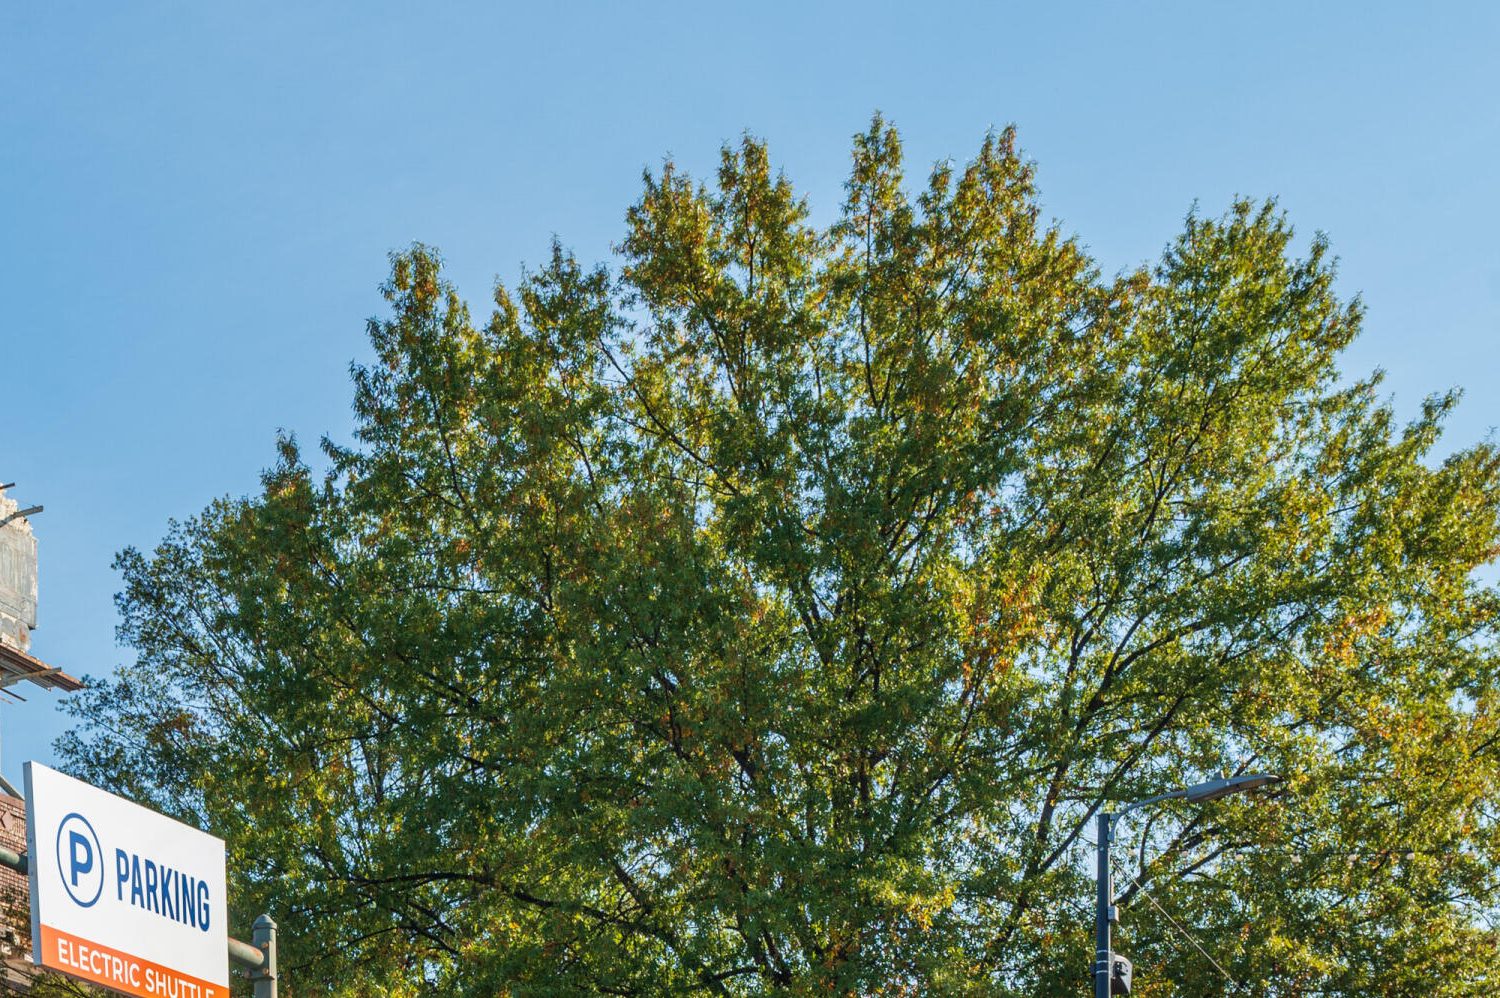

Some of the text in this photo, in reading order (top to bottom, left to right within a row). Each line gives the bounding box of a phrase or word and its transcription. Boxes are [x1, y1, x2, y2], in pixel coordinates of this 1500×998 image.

[69, 830, 210, 932] P PARKING
[57, 938, 141, 988] ELECTRIC
